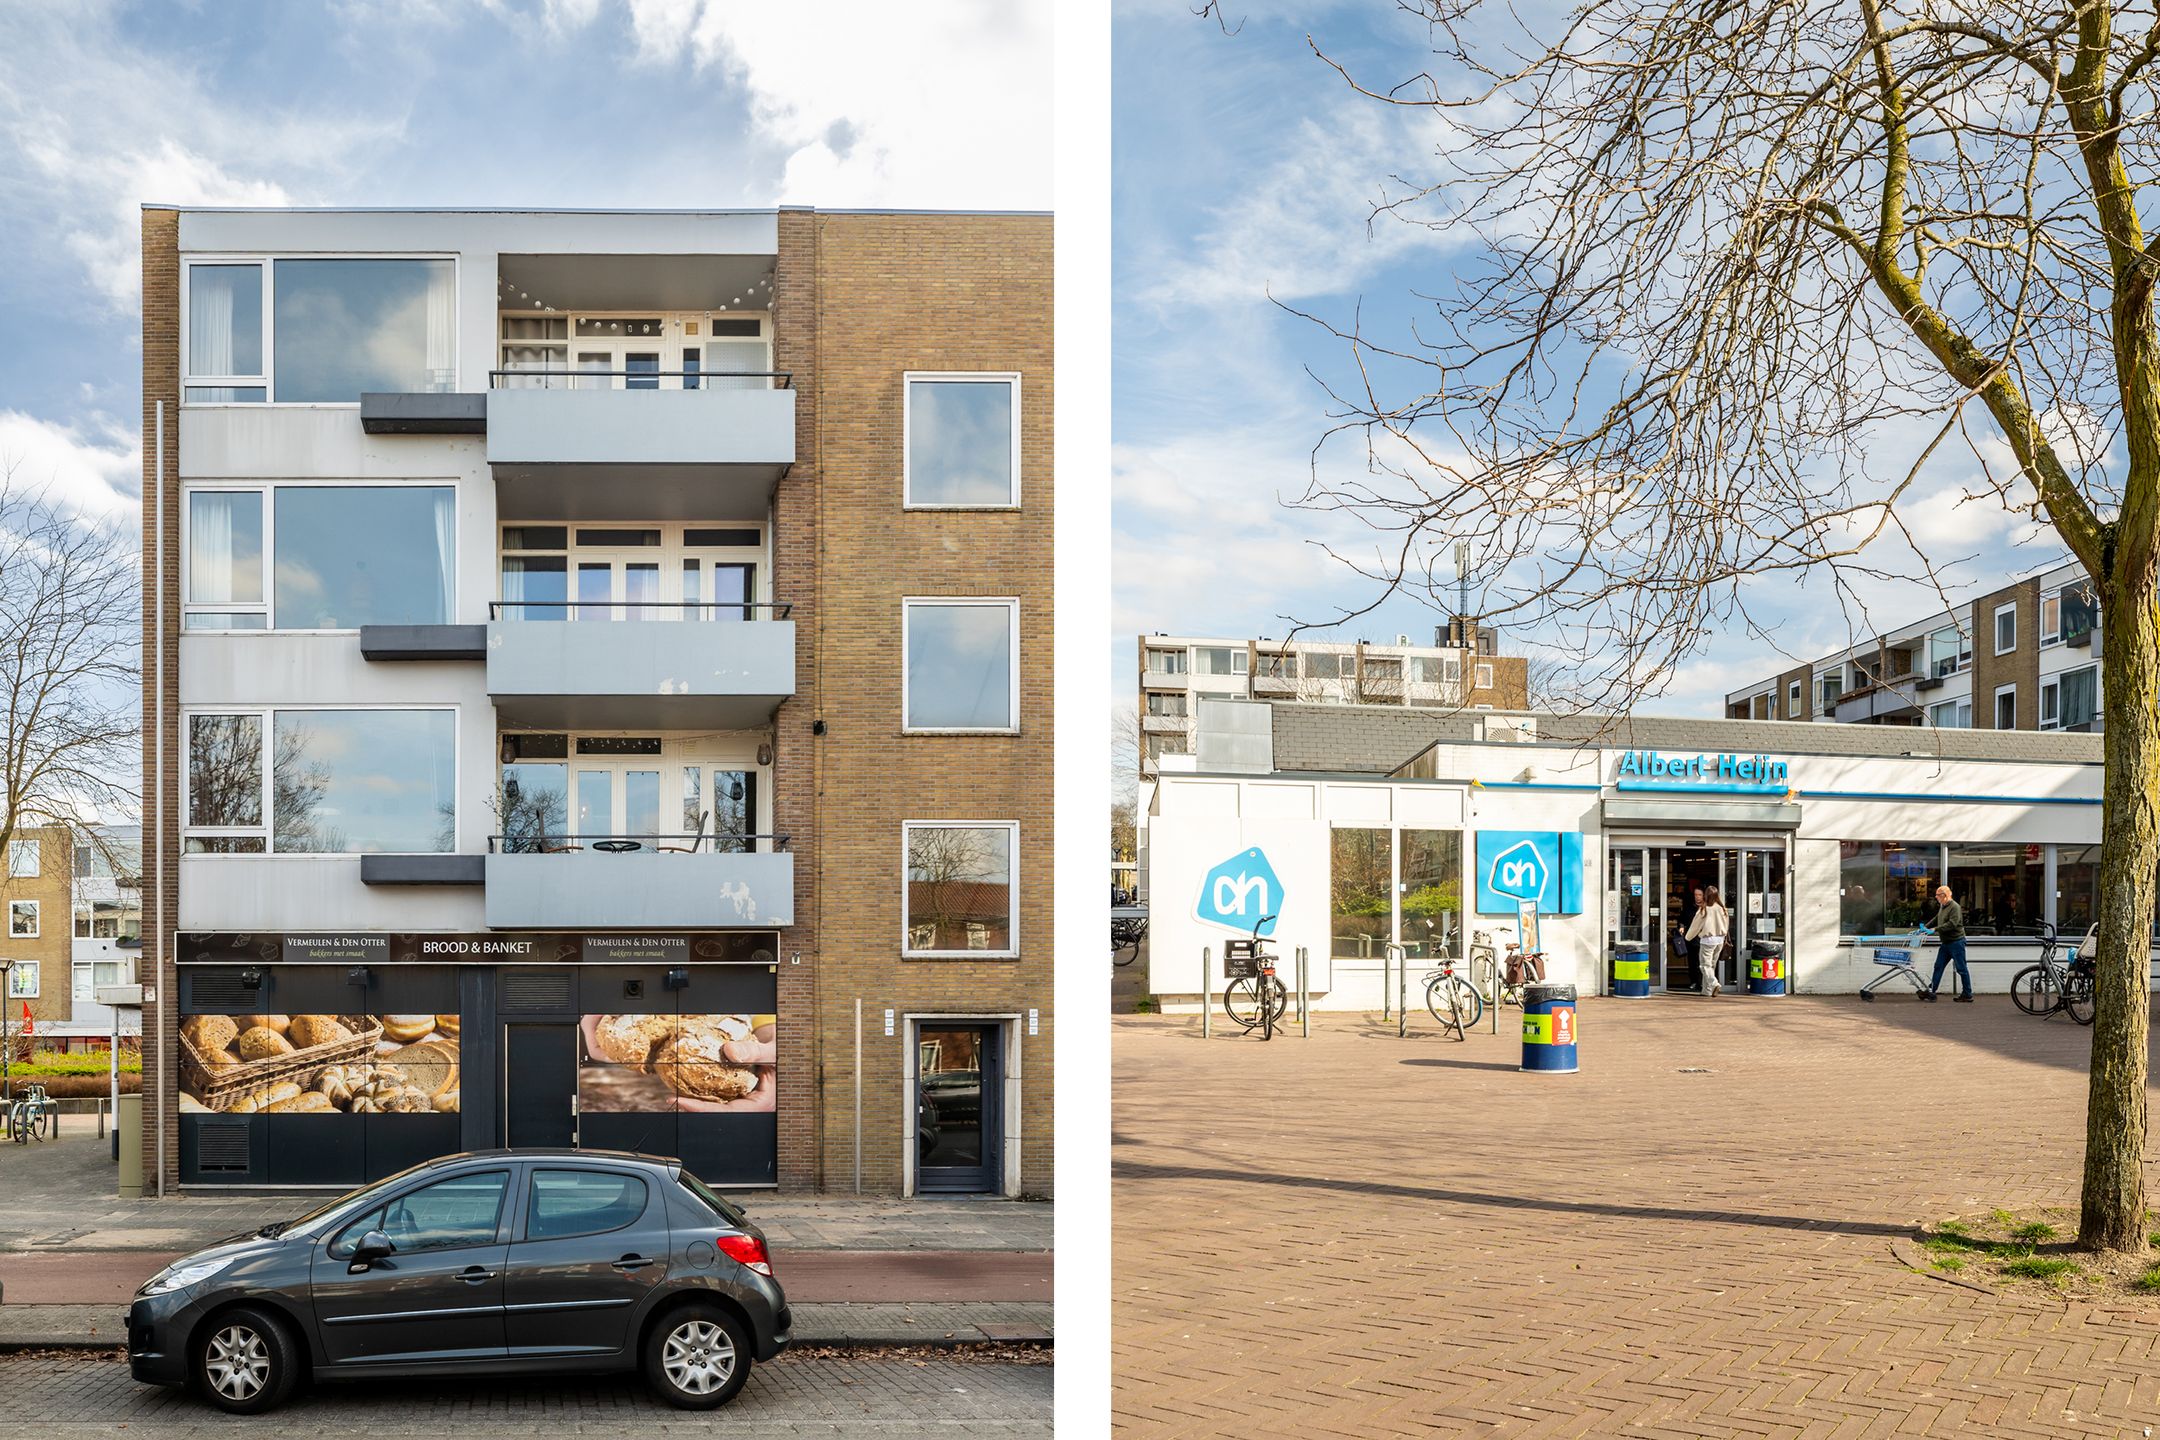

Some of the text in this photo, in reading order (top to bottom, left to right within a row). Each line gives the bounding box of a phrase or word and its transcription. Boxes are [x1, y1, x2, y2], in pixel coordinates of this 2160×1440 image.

[1619, 751, 1788, 784] Albert Heijn
[287, 938, 386, 947] VERMEULEN & DEN OTTER
[587, 938, 686, 947] VERMEULEN & DEN OTTER
[423, 941, 533, 954] BROOD & BANKET
[309, 949, 332, 958] bakkers
[345, 949, 366, 958] smaak
[609, 949, 632, 958] bakkers
[645, 949, 667, 958] smaak
